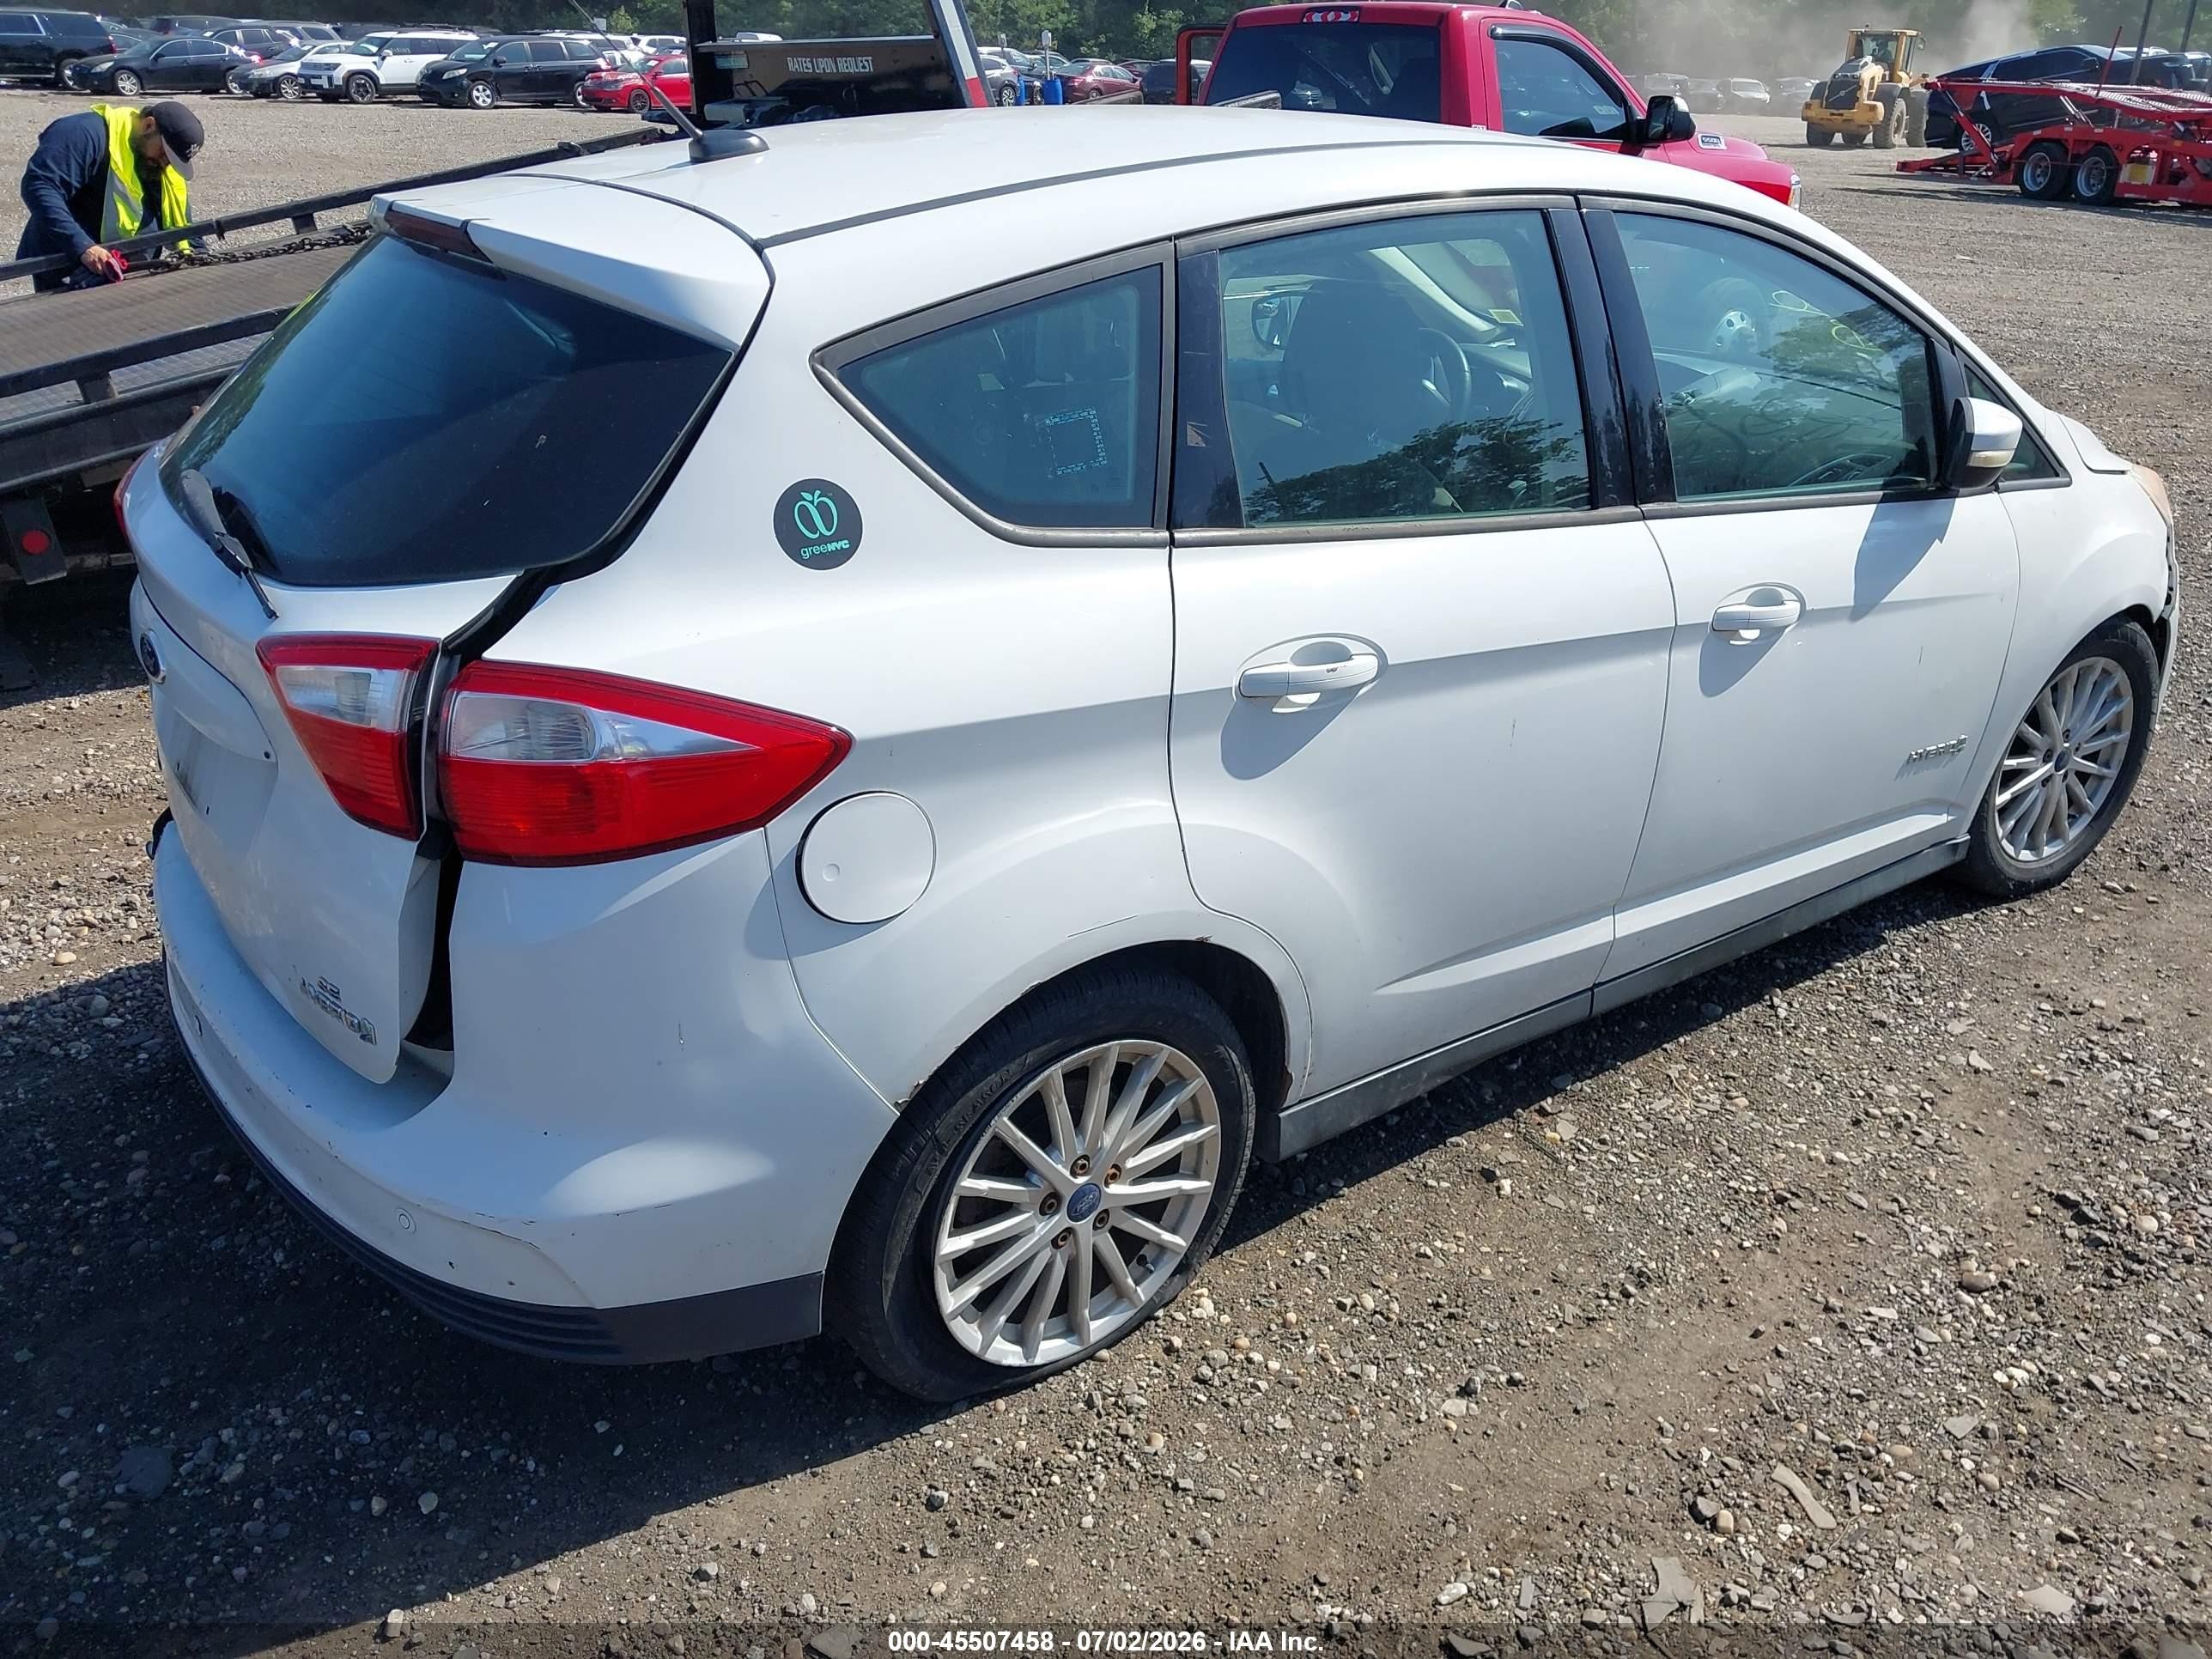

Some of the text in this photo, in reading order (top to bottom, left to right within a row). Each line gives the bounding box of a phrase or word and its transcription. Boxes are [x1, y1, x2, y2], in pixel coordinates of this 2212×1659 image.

[787, 56, 873, 74] RATES UPON REQUEST
